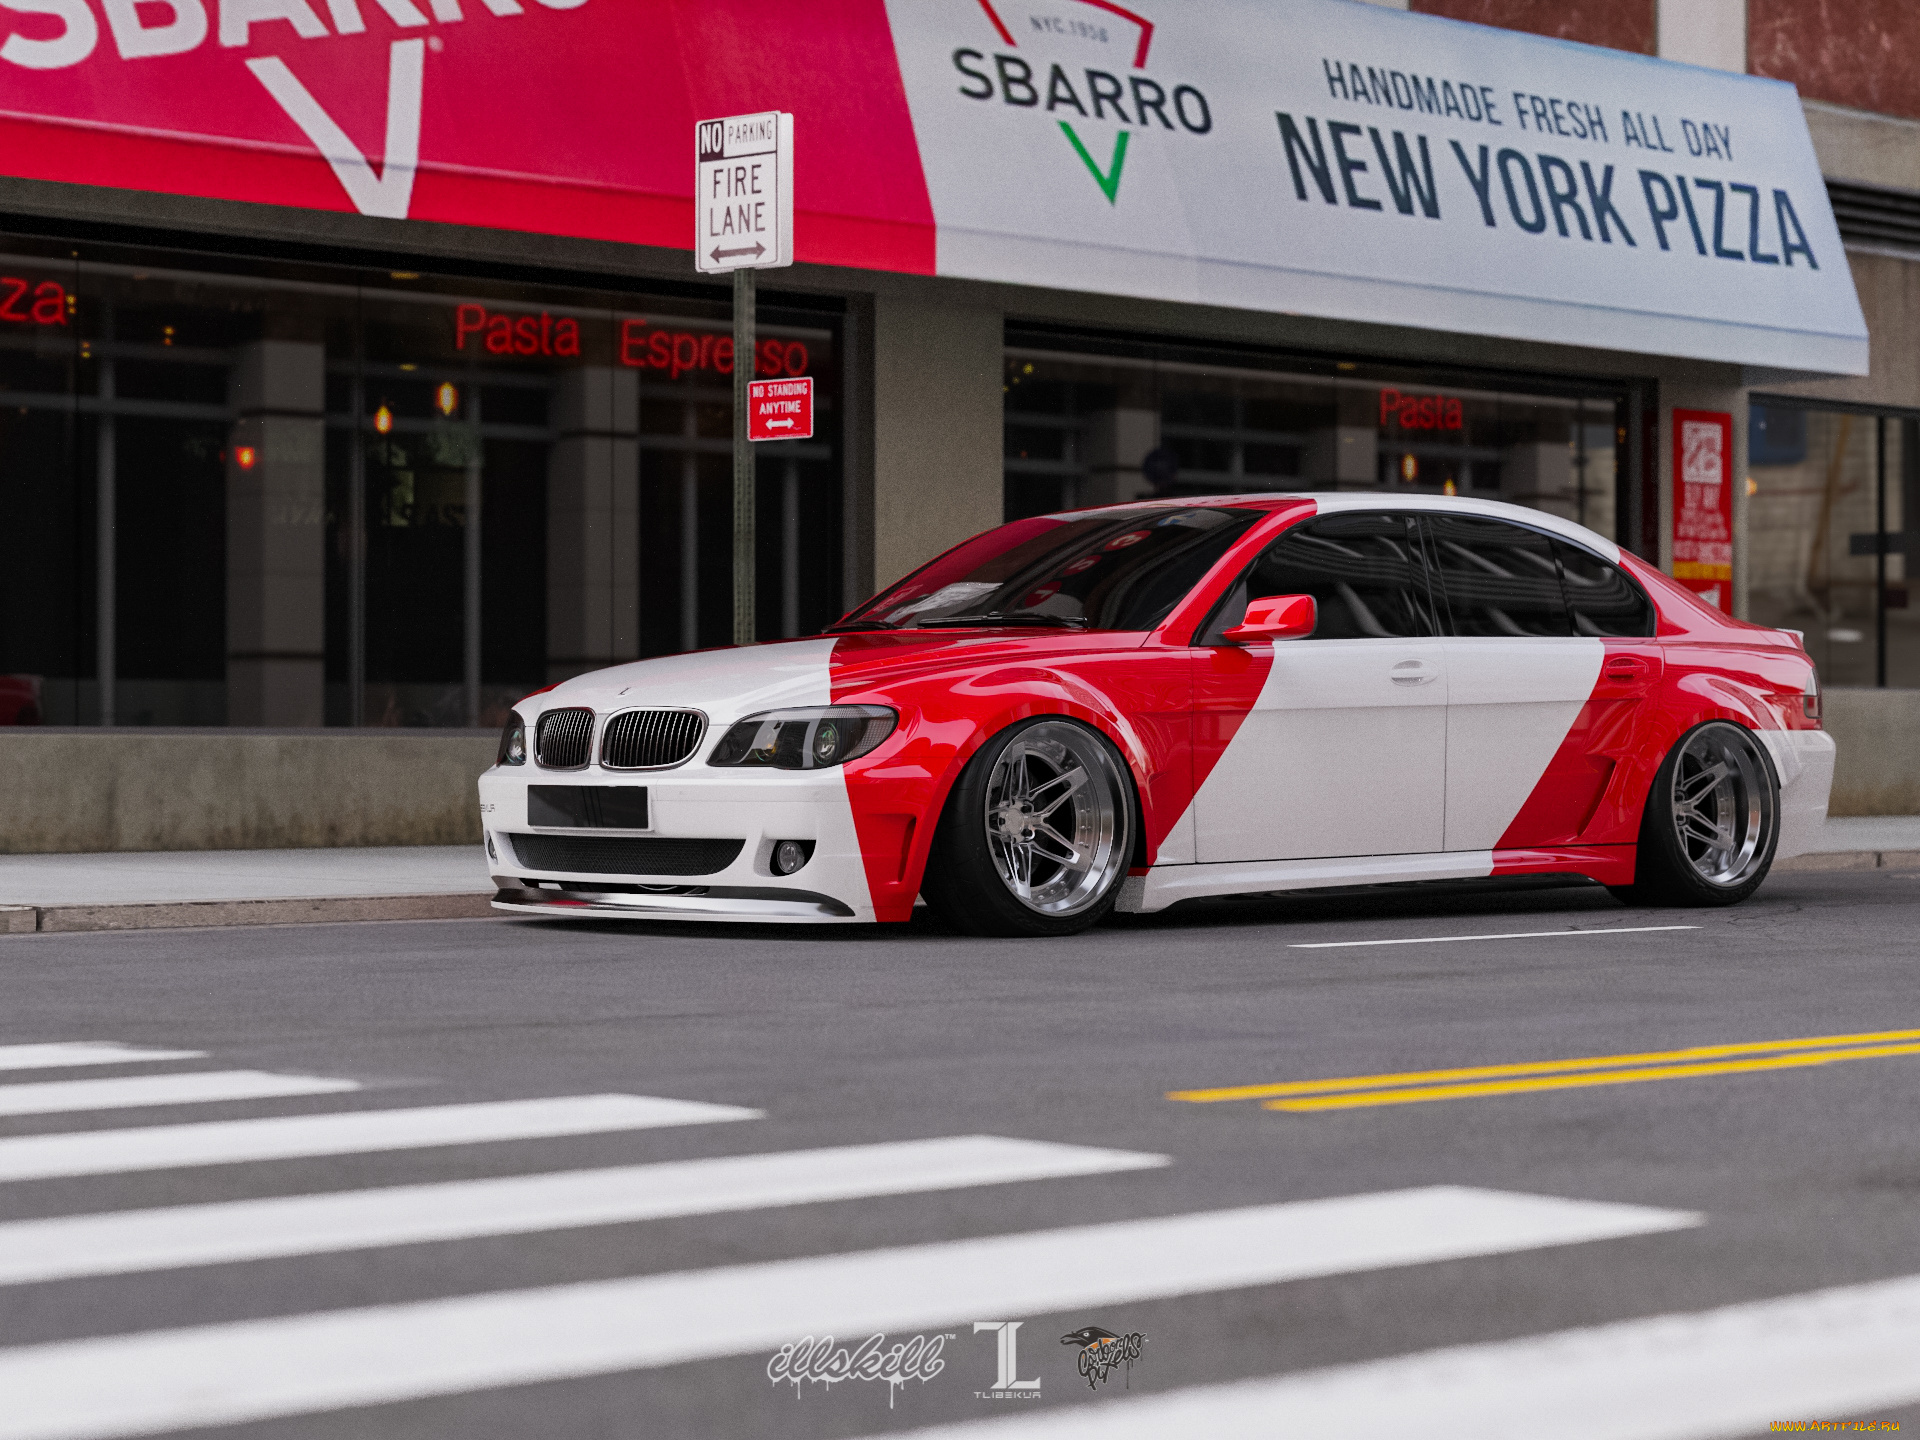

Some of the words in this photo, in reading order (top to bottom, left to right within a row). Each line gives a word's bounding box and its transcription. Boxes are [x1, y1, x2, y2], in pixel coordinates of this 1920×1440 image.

[952, 47, 1212, 135] SBARRO
[1323, 58, 1502, 126] HANDMADE
[1513, 92, 1610, 143] FRESH
[1622, 110, 1674, 154] ALL
[1681, 118, 1734, 162] DAY
[701, 122, 723, 154] NO
[728, 120, 773, 144] PARKING
[713, 164, 762, 199] FIRE
[1275, 111, 1441, 220] NEW
[1449, 139, 1638, 247] YORK
[1638, 169, 1820, 271] PIZZA
[710, 202, 766, 237] LANE
[455, 303, 581, 357] Pasta
[620, 319, 809, 379] Espreso
[752, 385, 764, 398] NO
[767, 382, 808, 397] STANDING
[759, 400, 801, 415] ANYTIME
[1380, 387, 1463, 430] Pasta
